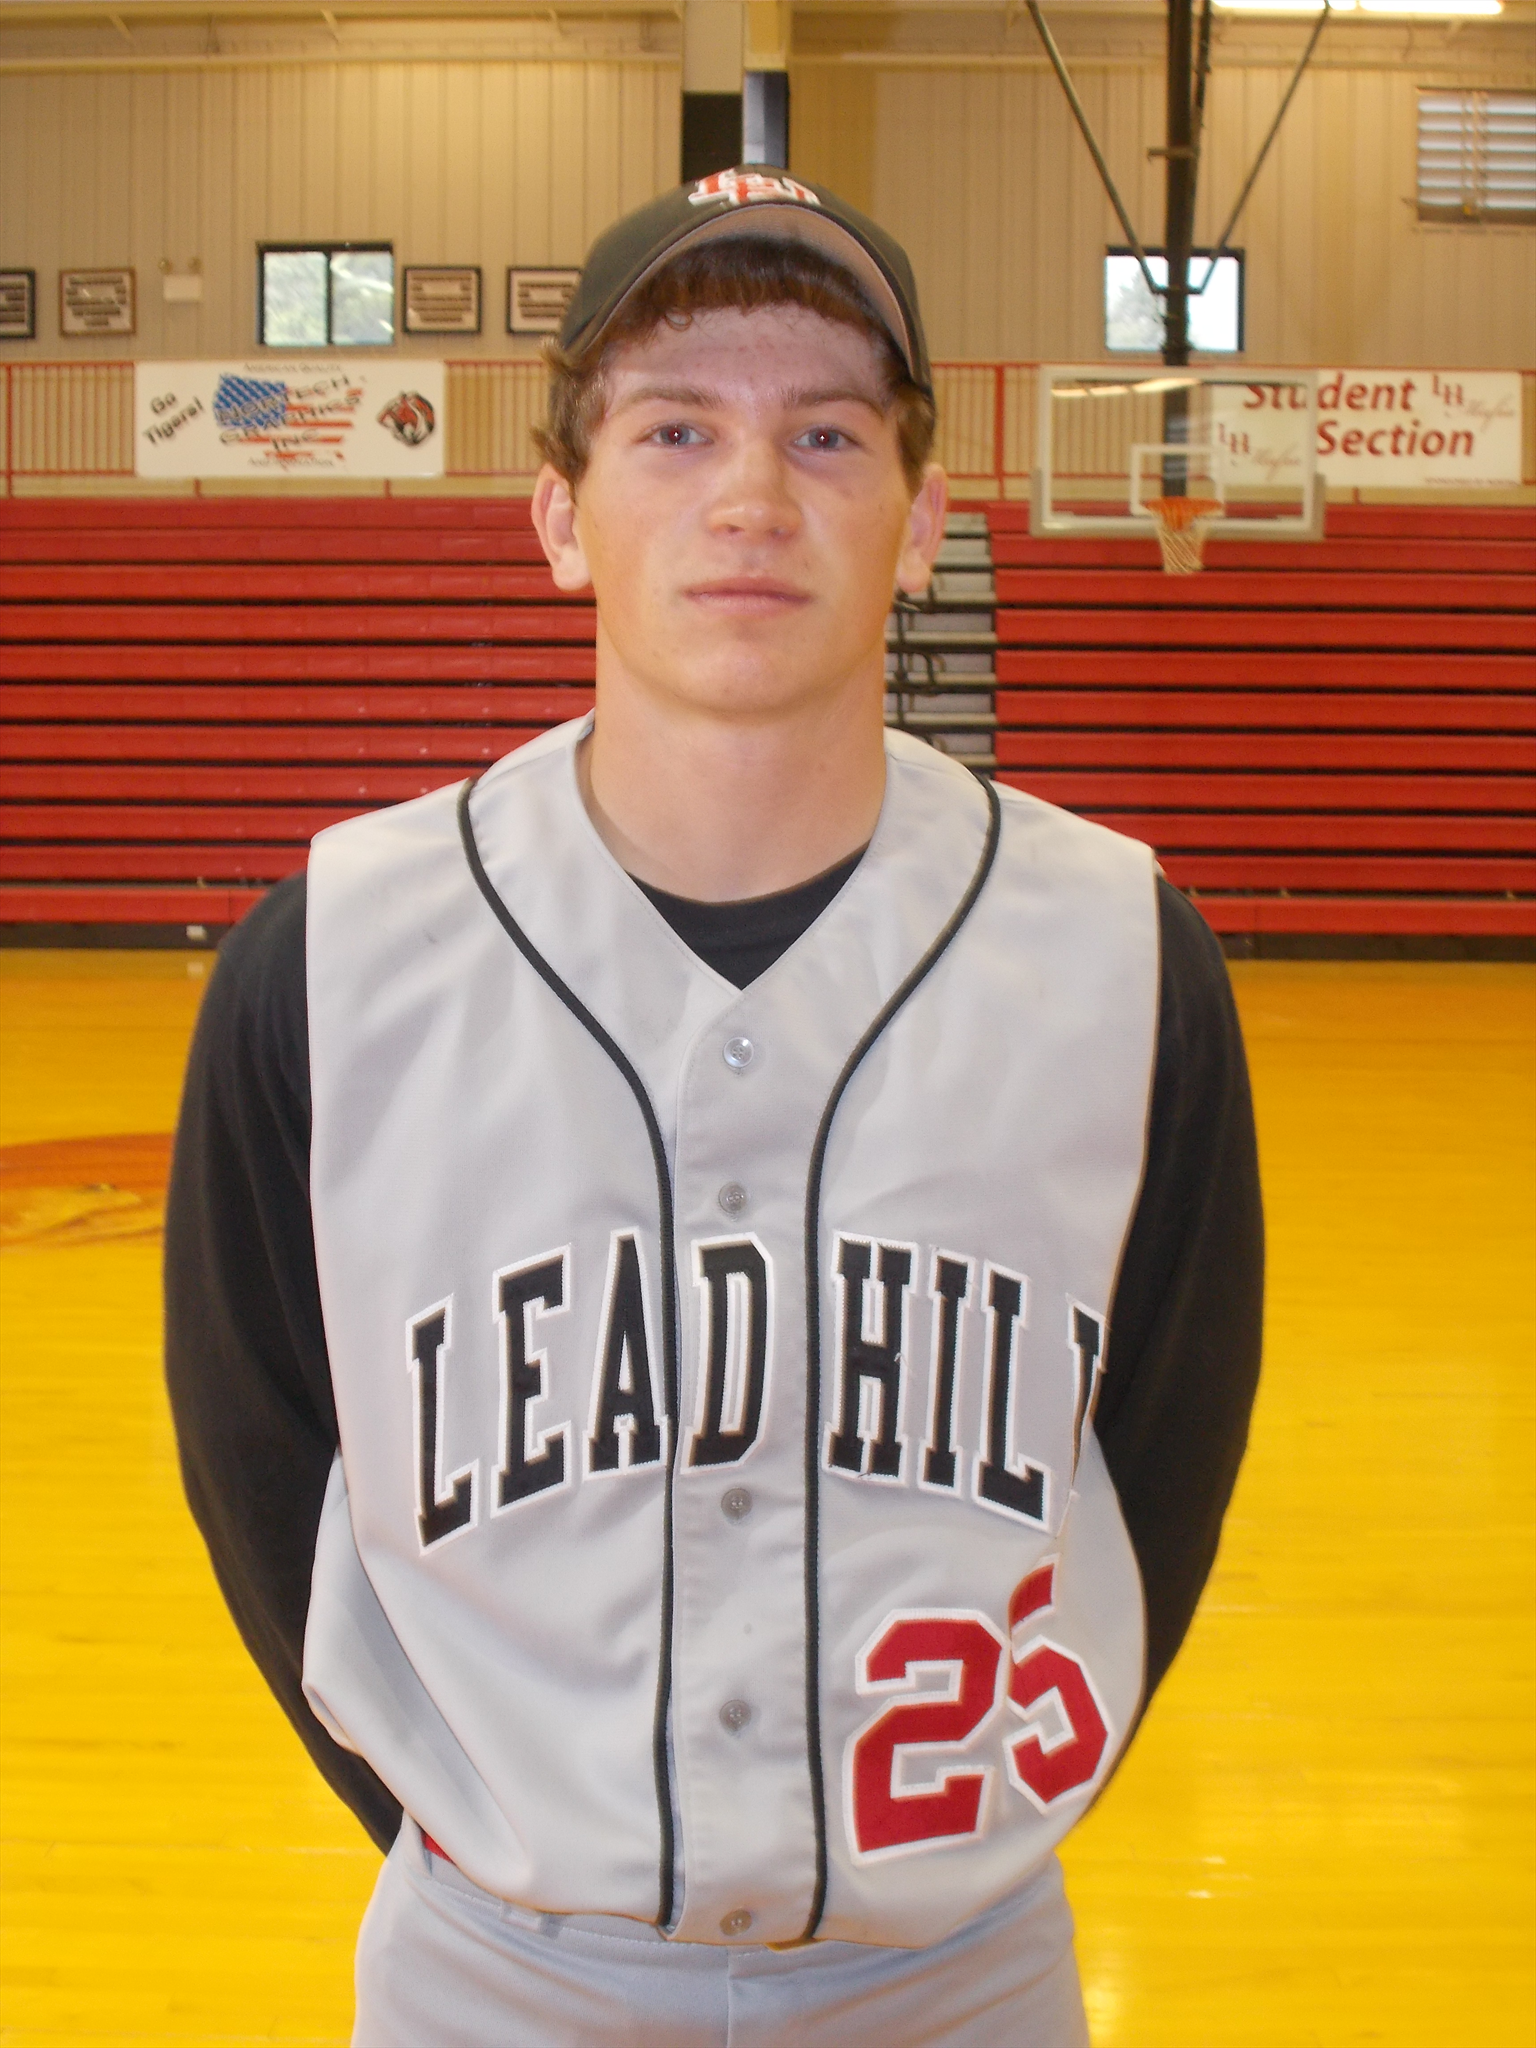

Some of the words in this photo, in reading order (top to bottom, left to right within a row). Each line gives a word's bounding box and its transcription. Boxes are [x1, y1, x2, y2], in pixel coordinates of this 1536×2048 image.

[150, 392, 177, 415] Go
[1315, 418, 1475, 457] Section
[405, 1226, 774, 1556] LEAD
[842, 1553, 1115, 1866] 25
